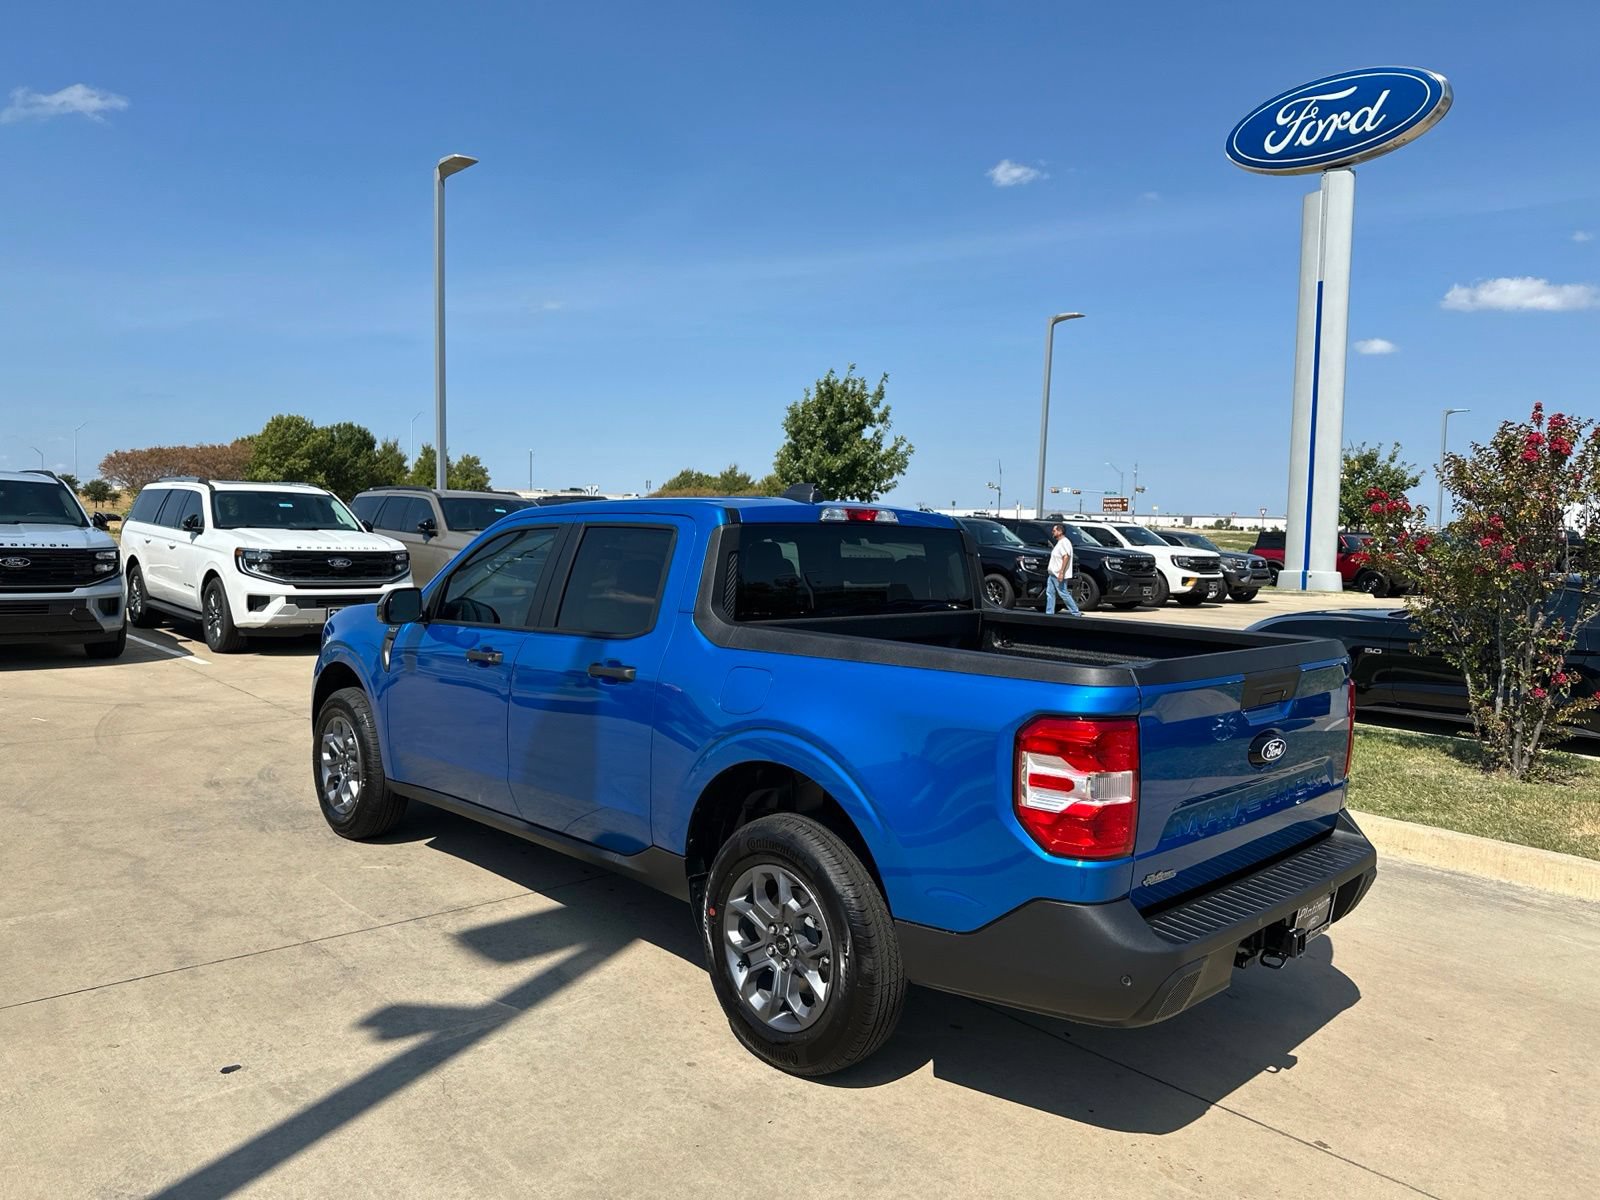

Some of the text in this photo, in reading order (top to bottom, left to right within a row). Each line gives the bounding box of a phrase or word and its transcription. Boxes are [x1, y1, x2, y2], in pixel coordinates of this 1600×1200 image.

[1264, 86, 1391, 154] Ford
[5, 557, 25, 566] Ford
[1266, 741, 1283, 758] Ford
